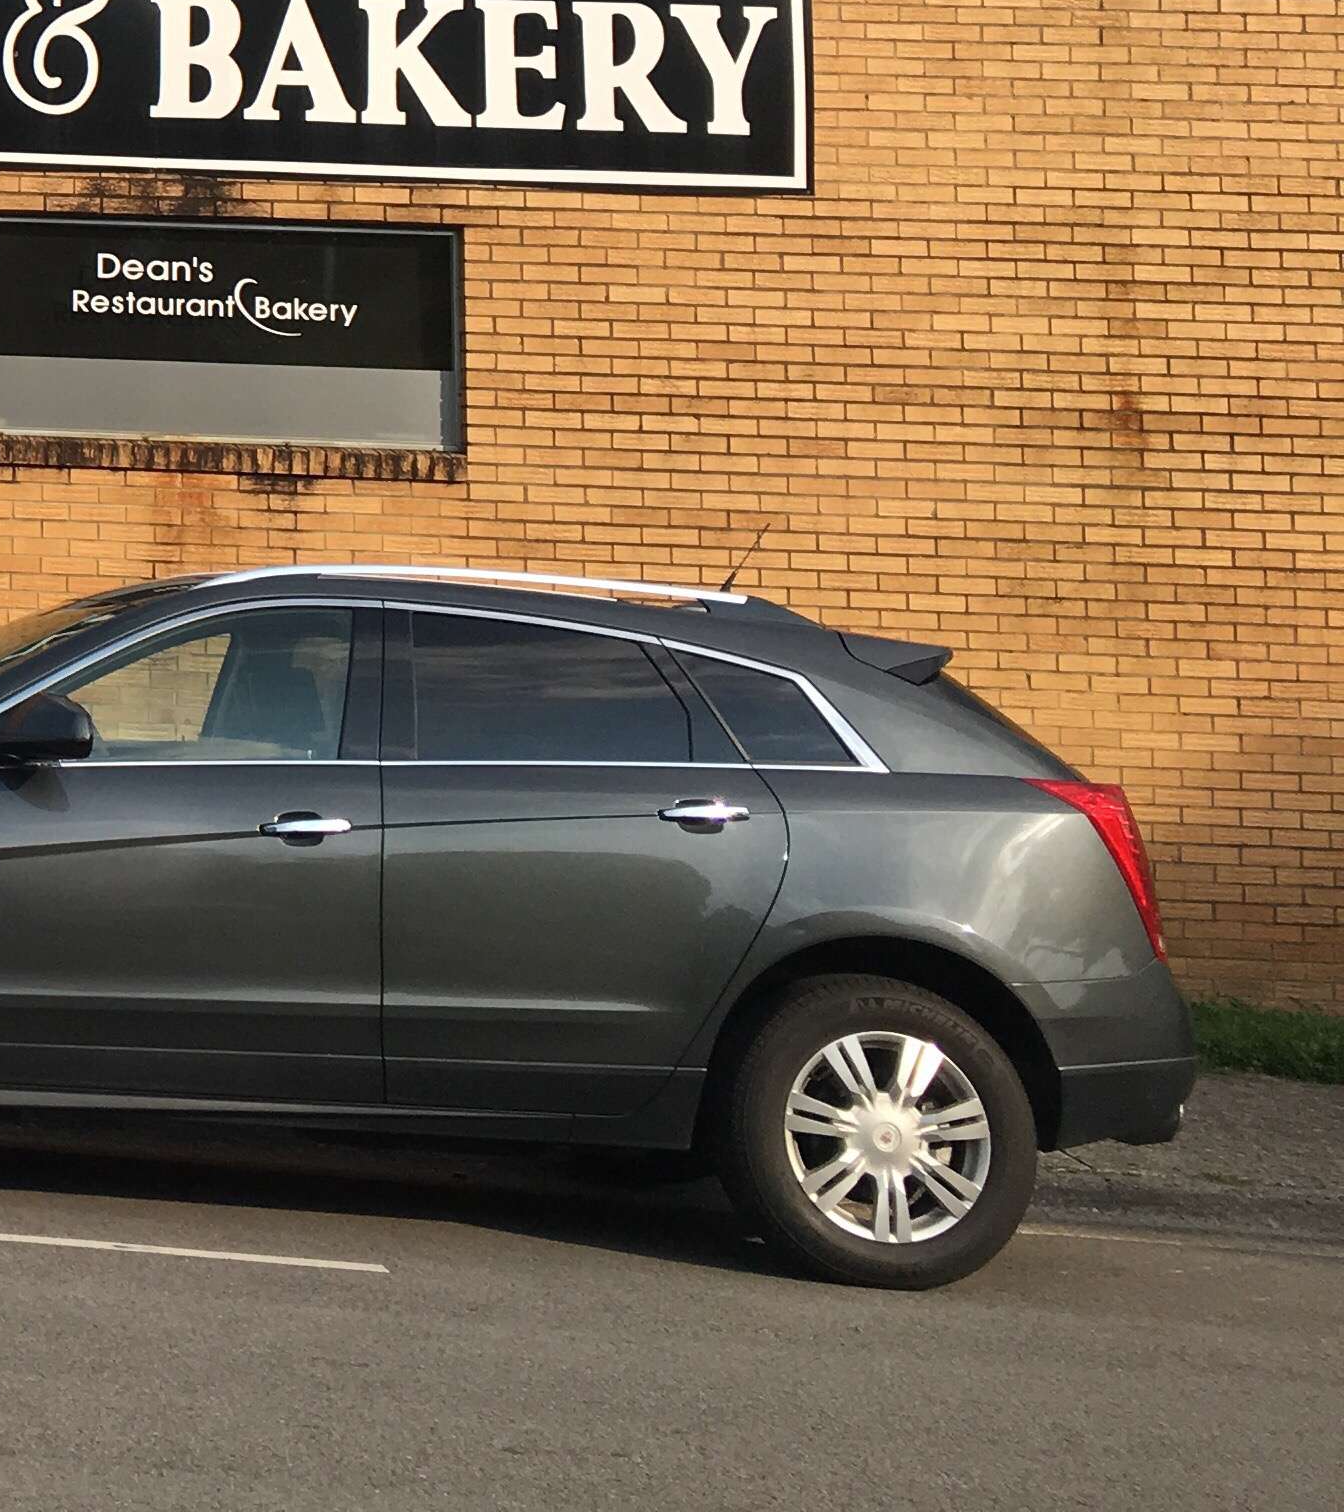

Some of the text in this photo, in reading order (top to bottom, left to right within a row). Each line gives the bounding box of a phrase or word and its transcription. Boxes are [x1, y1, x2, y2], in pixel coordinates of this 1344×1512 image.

[98, 253, 214, 283] Dean's
[73, 289, 358, 327] Restaurant Bakery
